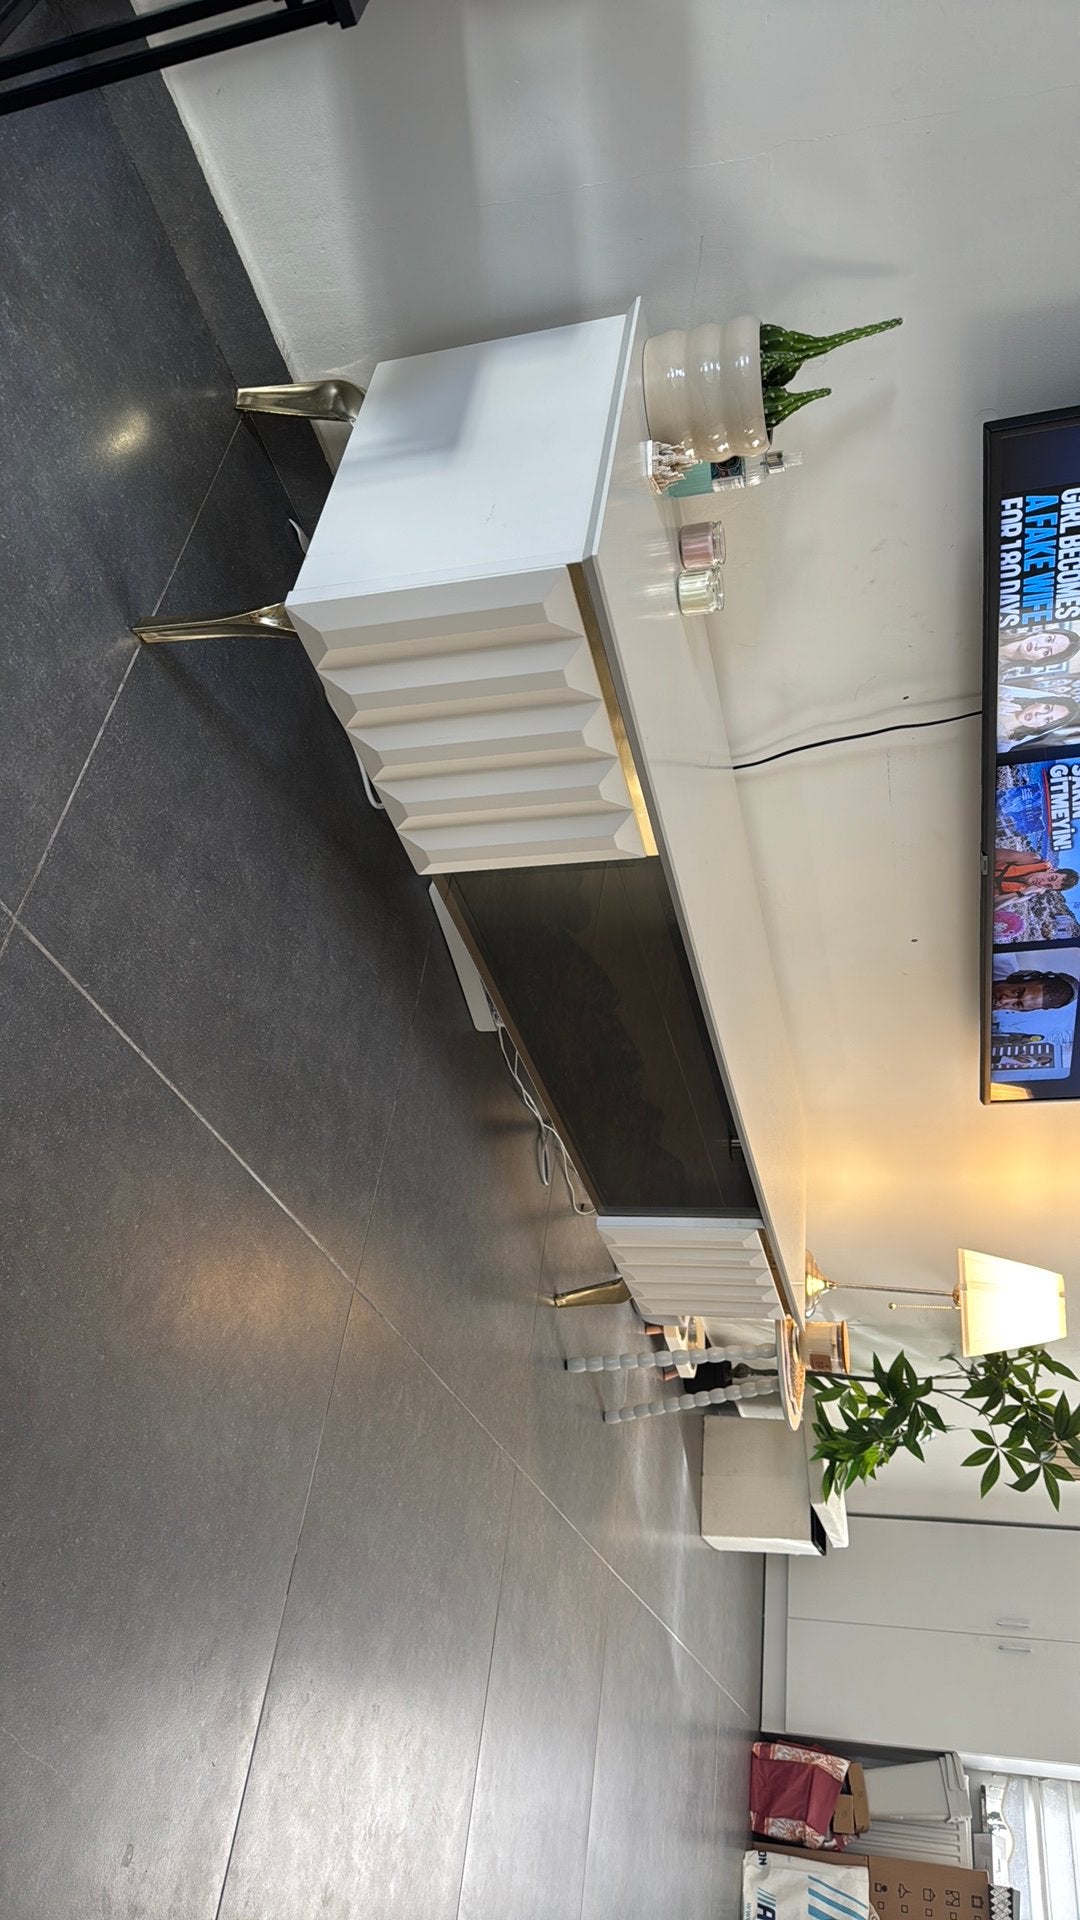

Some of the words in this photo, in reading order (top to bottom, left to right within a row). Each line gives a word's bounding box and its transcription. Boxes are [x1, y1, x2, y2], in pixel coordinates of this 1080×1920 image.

[1000, 496, 1023, 538] FOR
[1025, 495, 1058, 513] A
[1059, 488, 1080, 534] GIRL
[1000, 540, 1022, 579] 180
[1023, 512, 1058, 572] FAKE
[1021, 571, 1055, 625] WIFE
[1054, 534, 1080, 620] BECOMES
[999, 580, 1022, 628] DAYS
[1050, 764, 1075, 850] GİTMEYİN!
